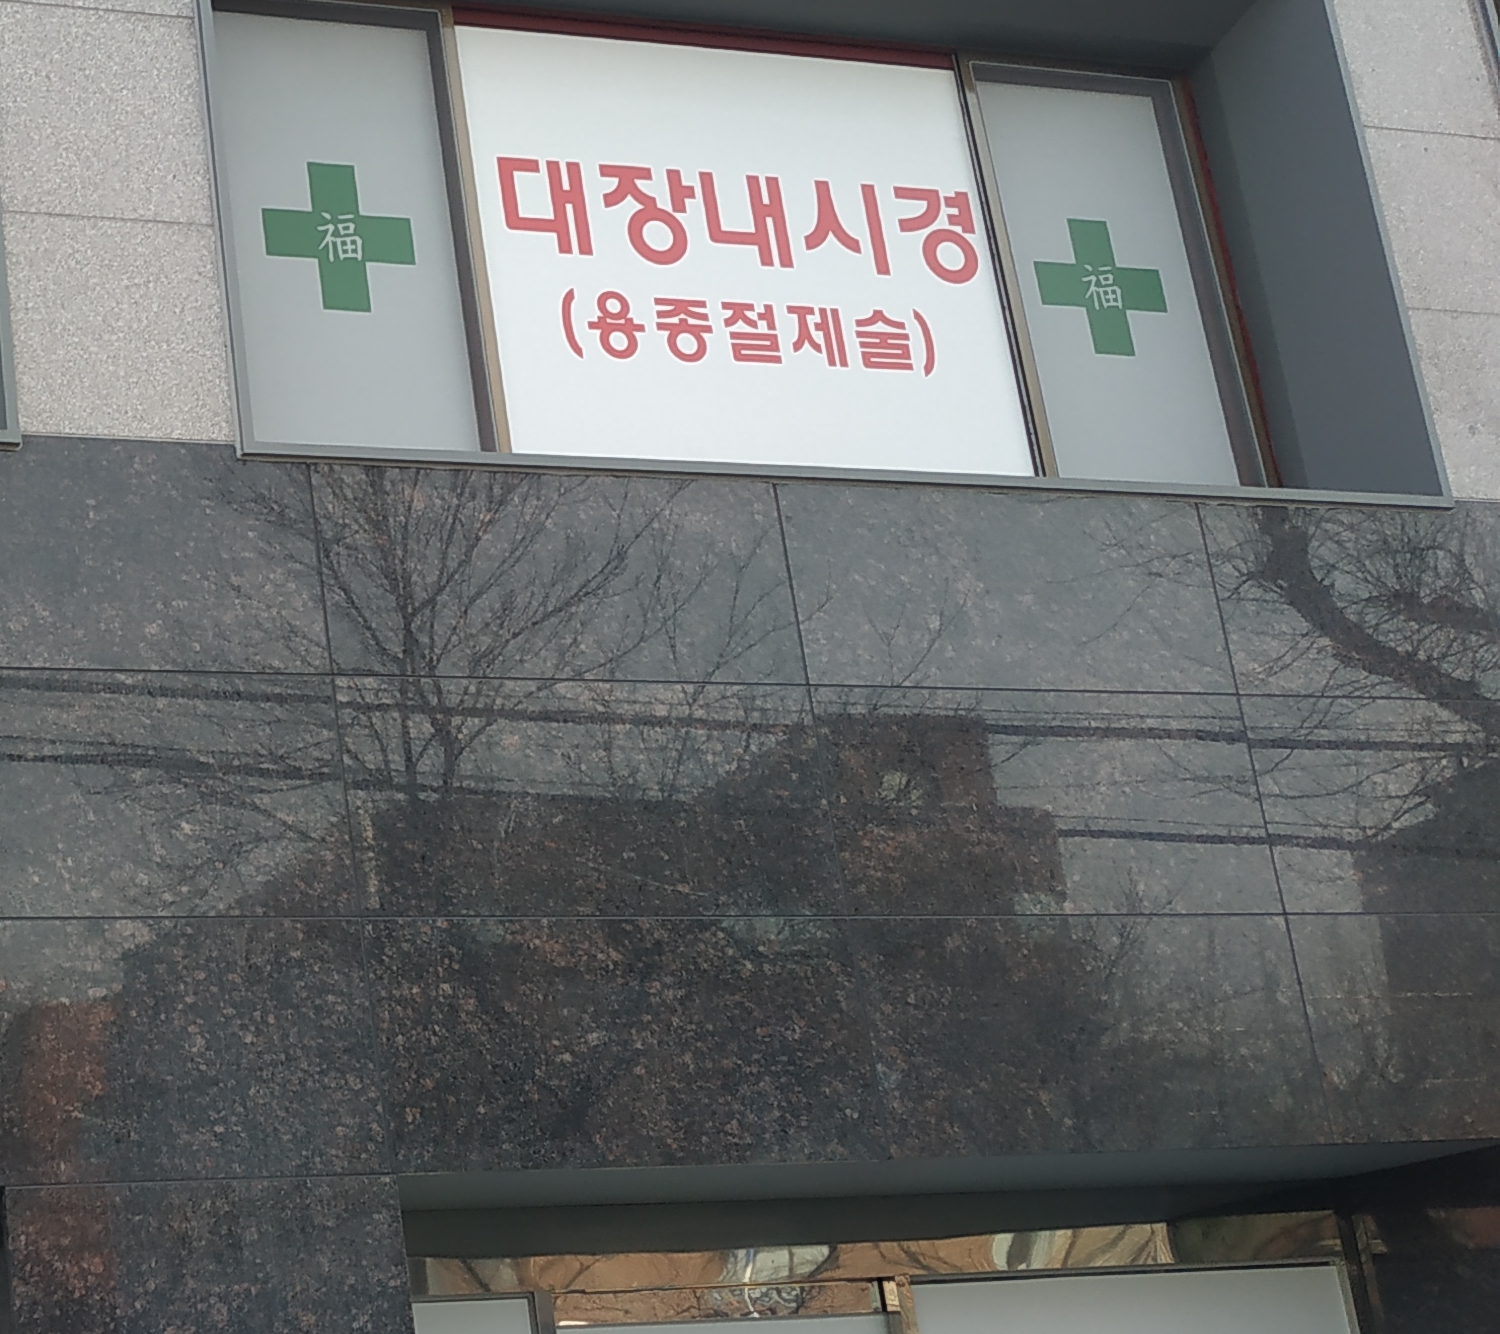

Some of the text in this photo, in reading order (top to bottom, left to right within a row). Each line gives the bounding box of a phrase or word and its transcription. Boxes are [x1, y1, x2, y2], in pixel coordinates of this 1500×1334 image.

[318, 212, 365, 266] 福
[496, 154, 981, 286] 대장내시경
[1082, 264, 1124, 315] 福
[560, 286, 938, 378] (용종절제술)
